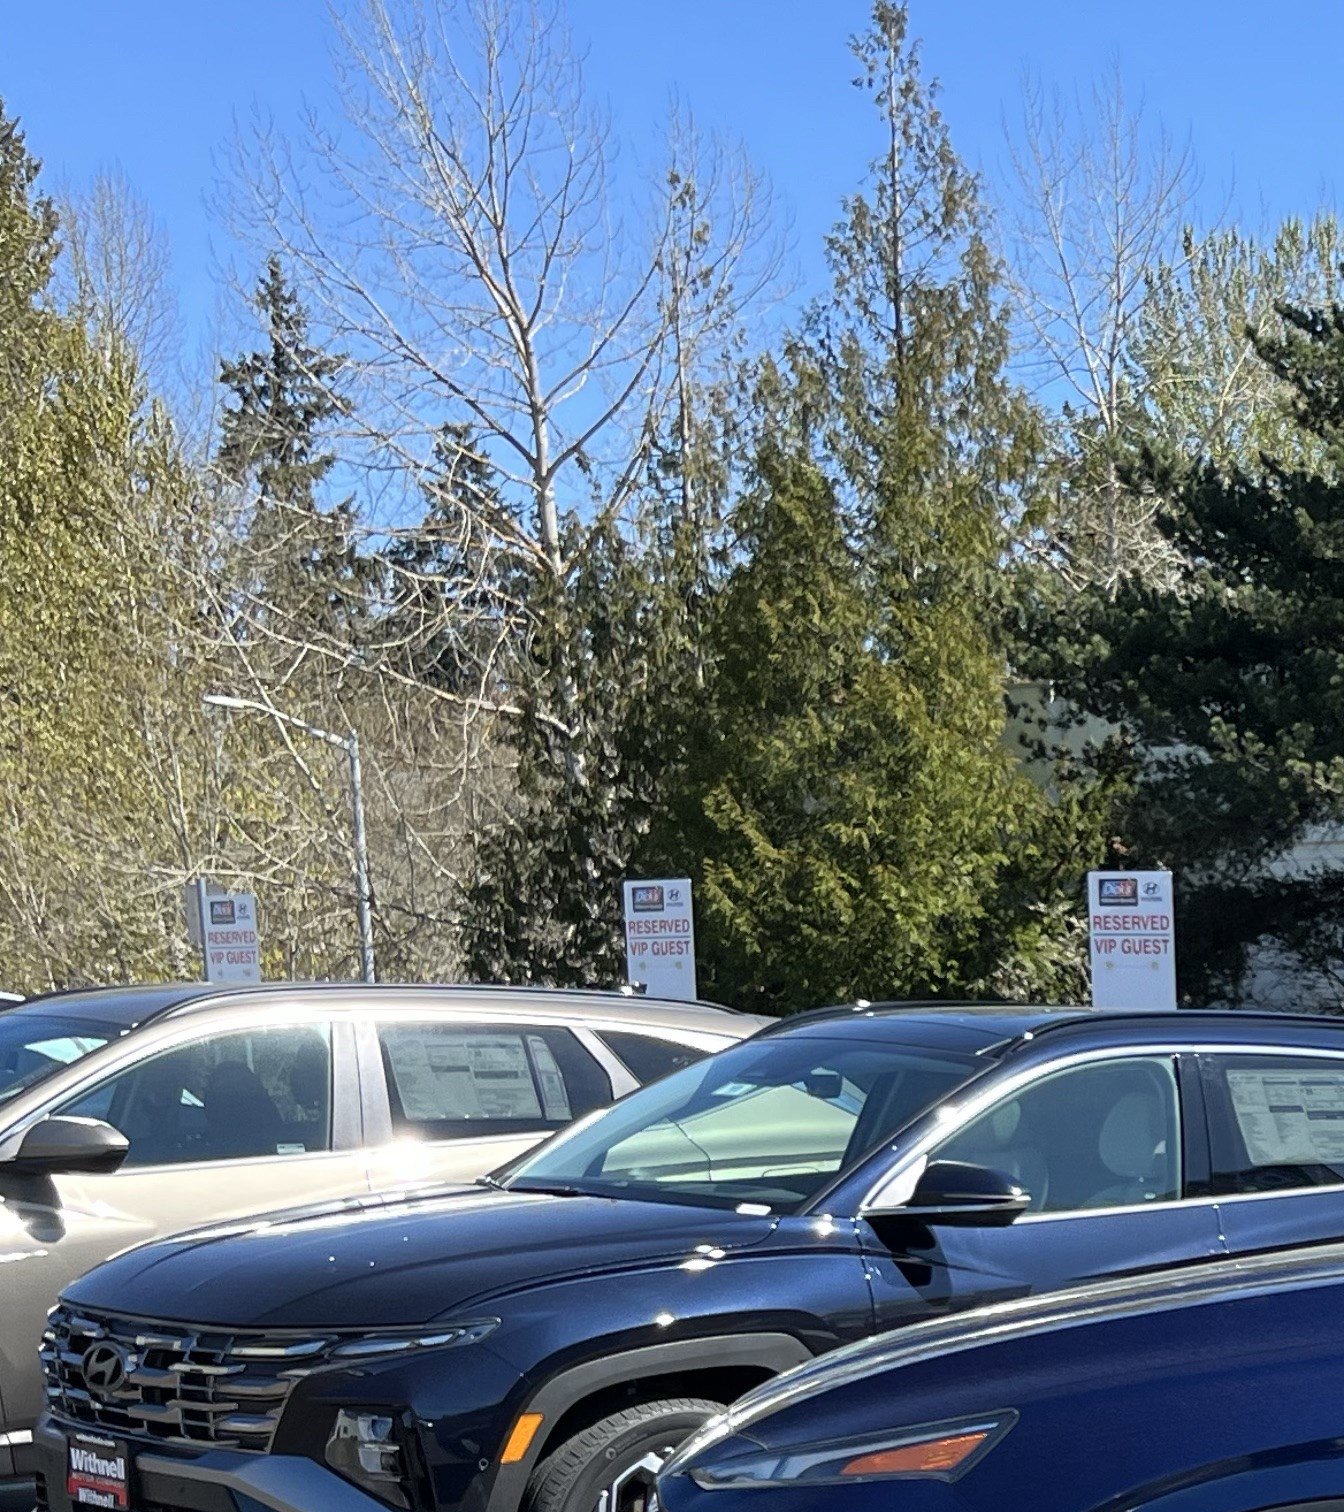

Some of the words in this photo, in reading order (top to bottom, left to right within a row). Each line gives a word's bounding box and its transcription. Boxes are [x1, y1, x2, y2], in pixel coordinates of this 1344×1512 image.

[628, 919, 690, 934] RESERVED
[1092, 915, 1170, 931] RESERVED
[208, 931, 256, 945] RESERVED
[630, 941, 648, 956] VIP
[651, 940, 690, 956] GUEST
[1094, 938, 1117, 955] VIP
[1121, 938, 1170, 955] GUEST
[226, 950, 256, 965] GUEST
[69, 1446, 125, 1480] Withnell
